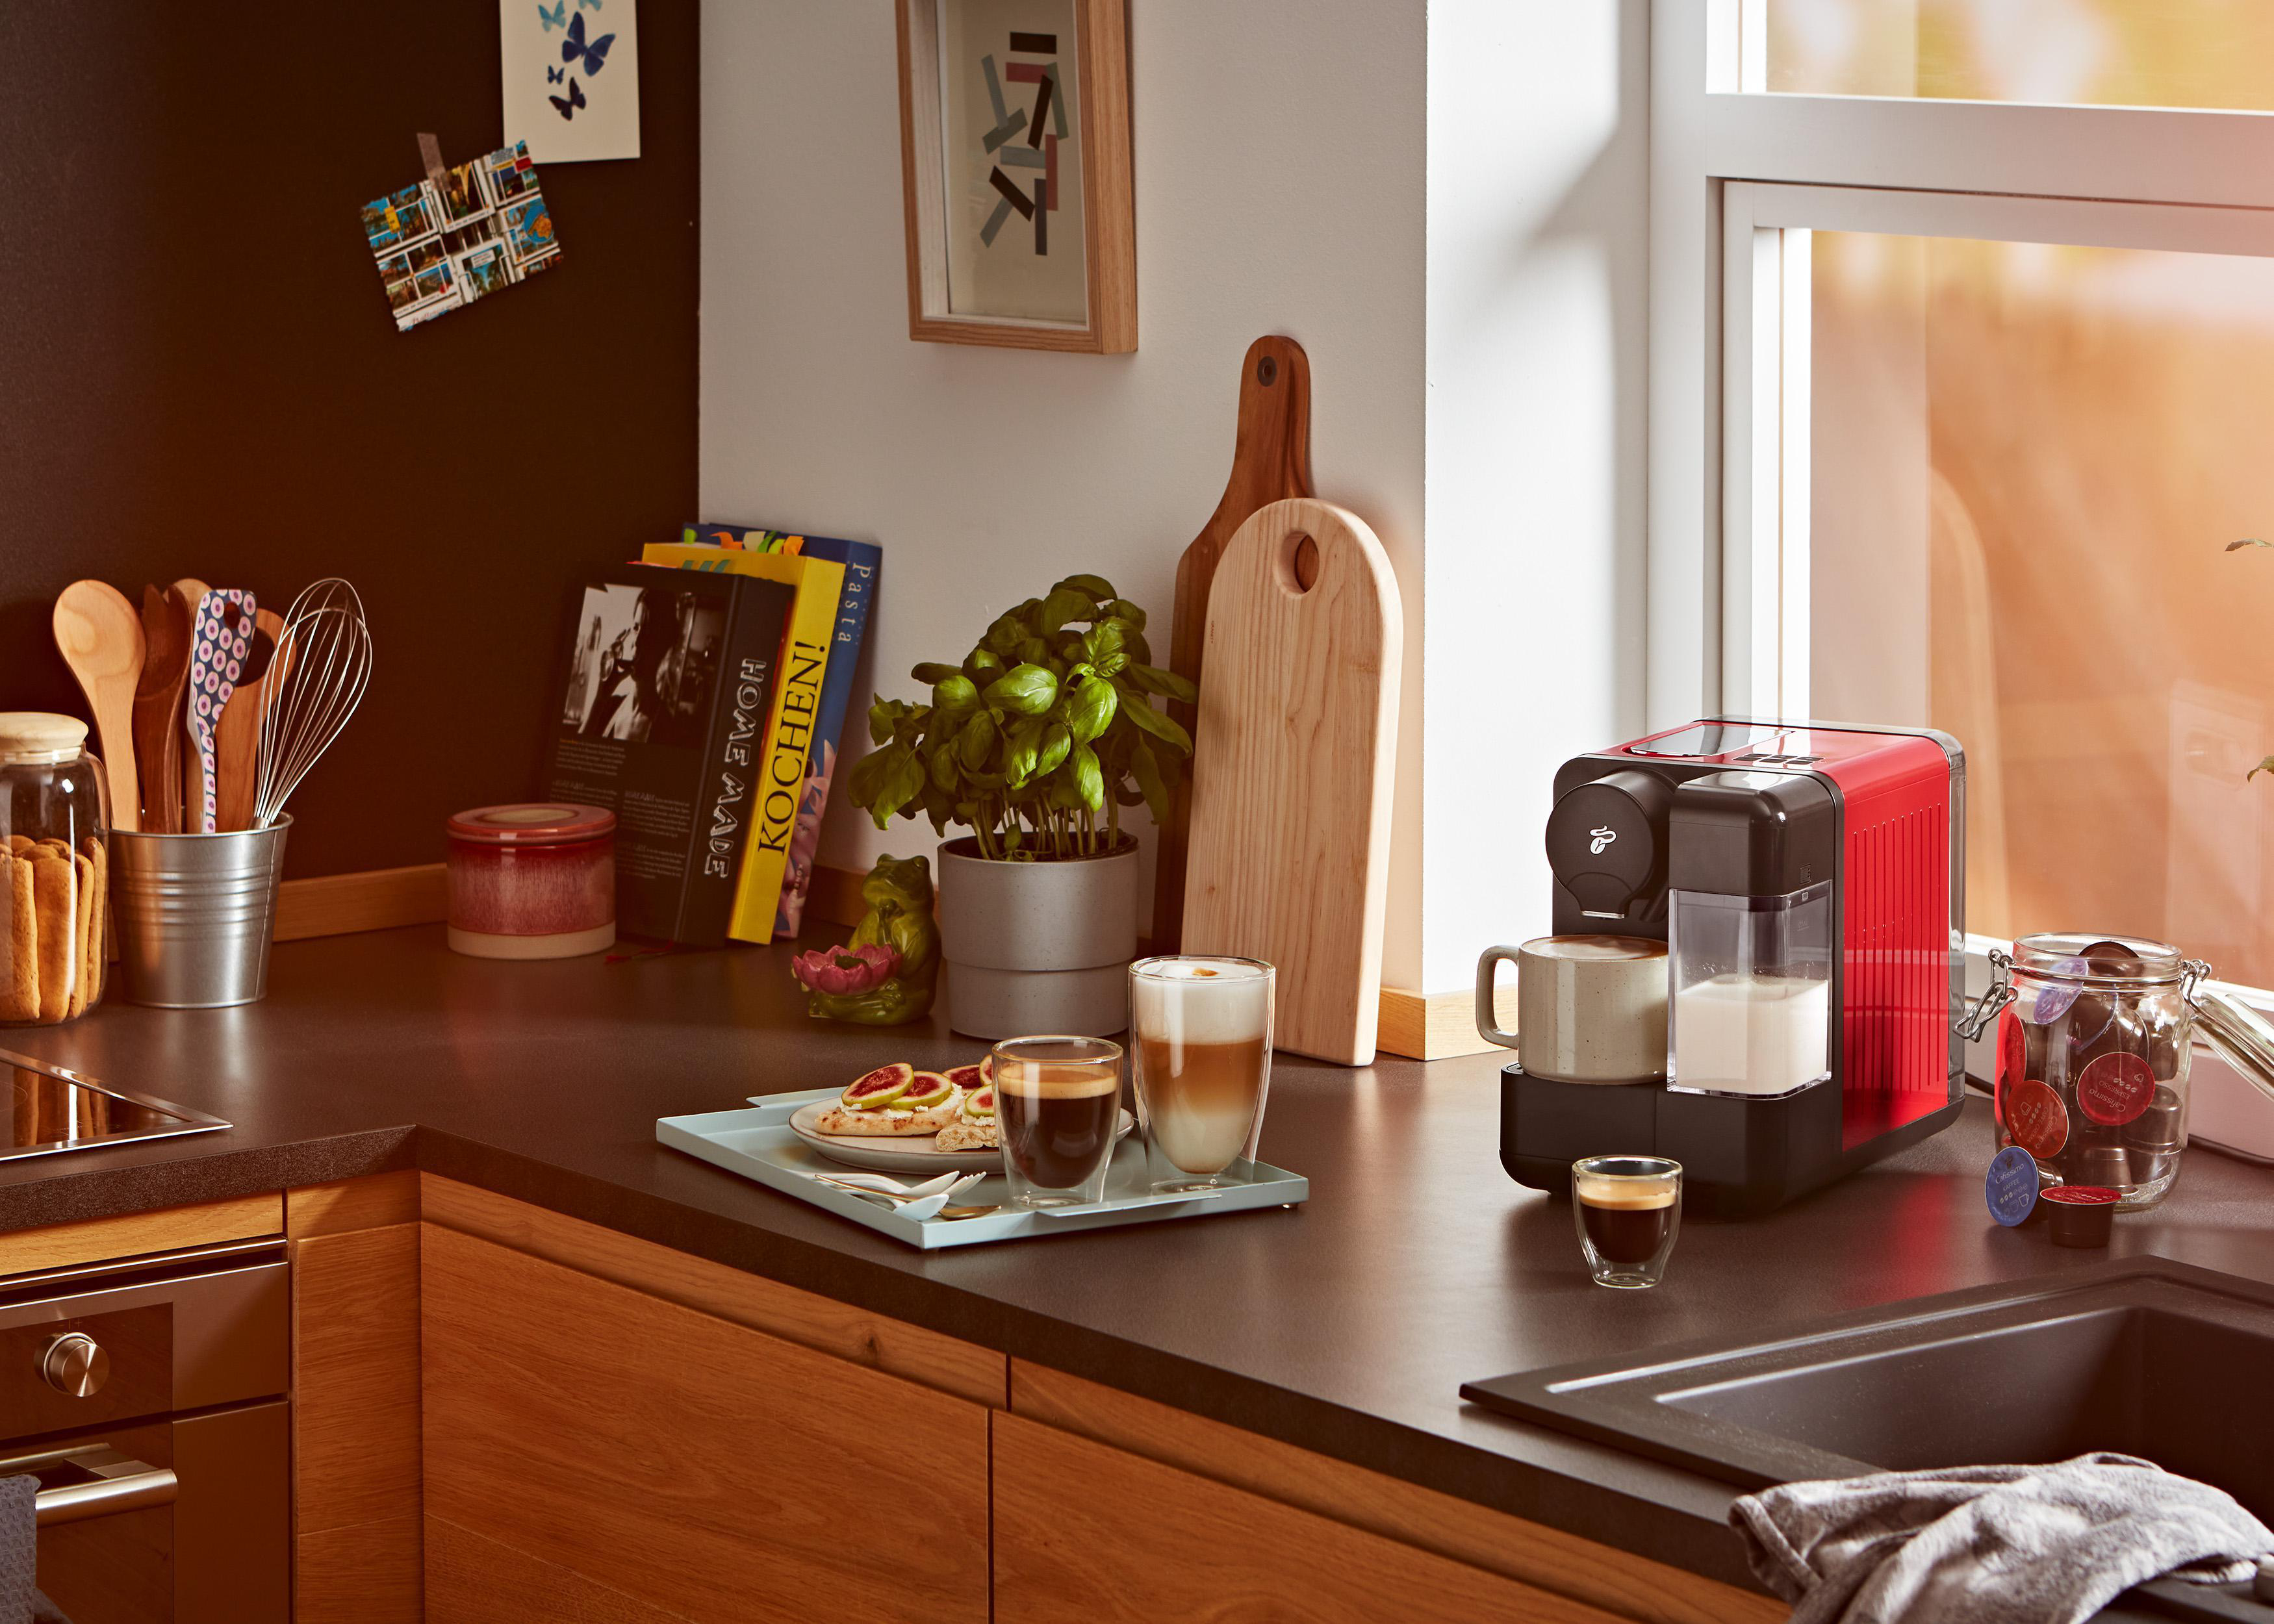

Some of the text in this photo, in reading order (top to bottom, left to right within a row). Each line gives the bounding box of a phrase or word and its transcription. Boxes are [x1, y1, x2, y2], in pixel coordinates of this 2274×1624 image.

[838, 563, 872, 642] Pasta
[704, 658, 767, 878] HOME MADE
[758, 641, 825, 857] KOCHEN!
[2089, 1088, 2126, 1112] Cafissimo
[2099, 1080, 2131, 1100] ESPRESSO
[1995, 1163, 2025, 1184] Cafissimo
